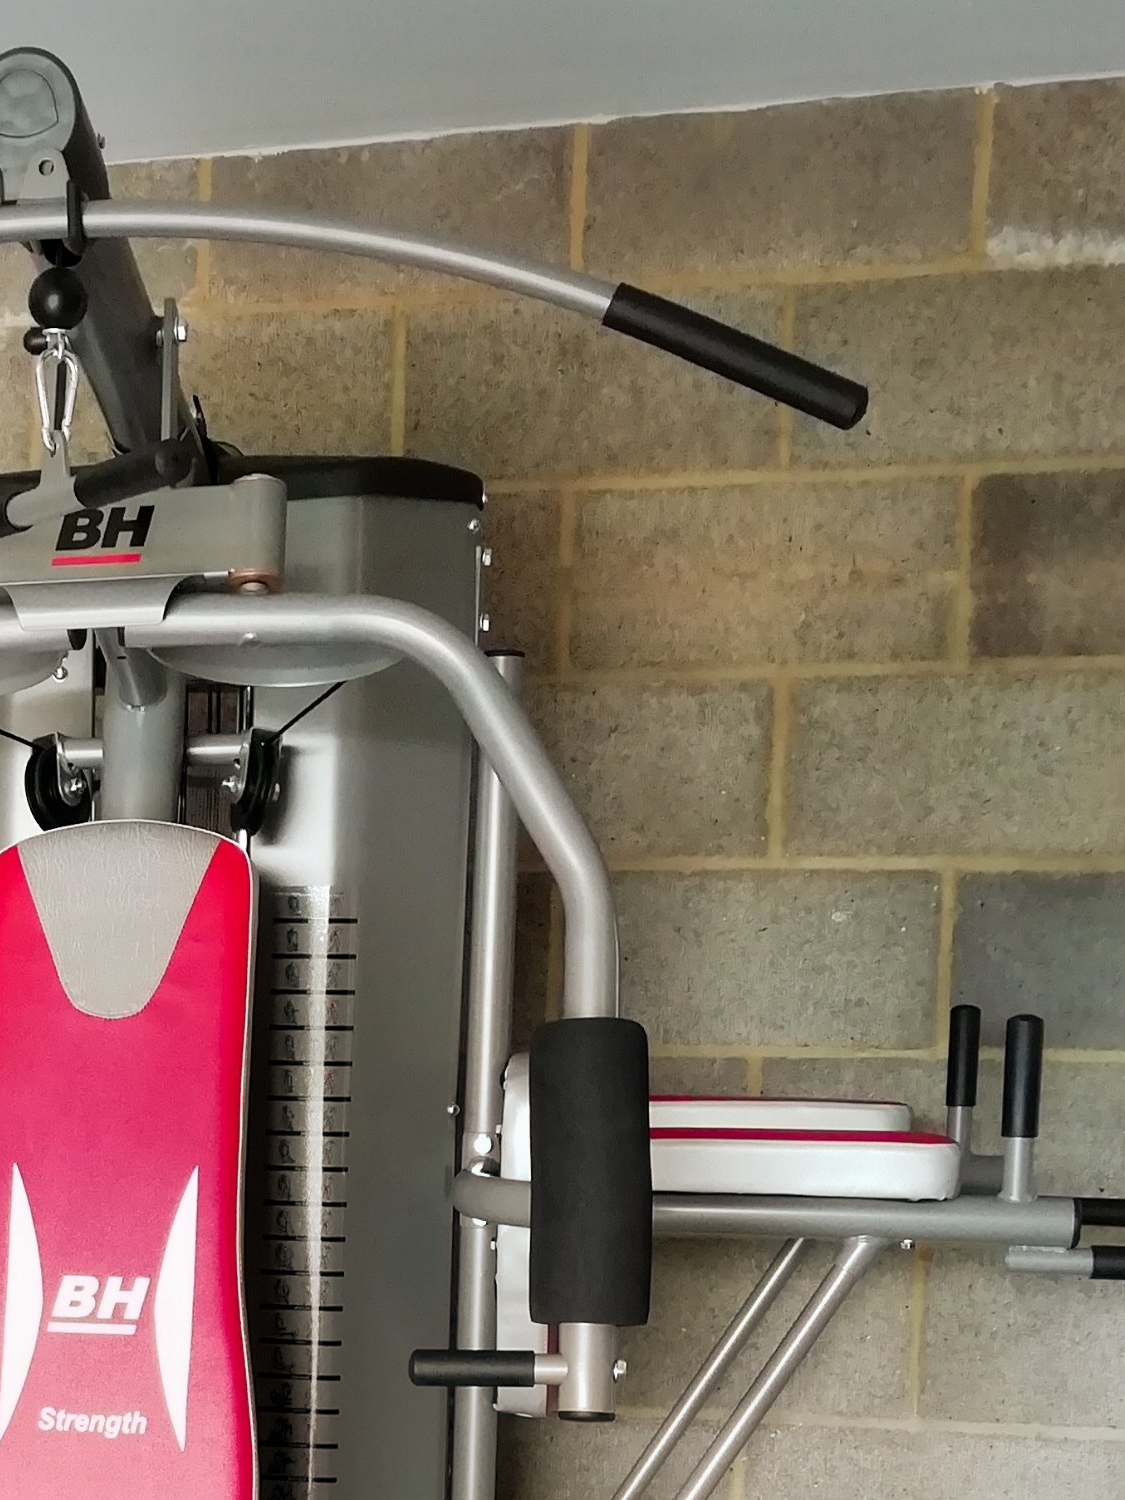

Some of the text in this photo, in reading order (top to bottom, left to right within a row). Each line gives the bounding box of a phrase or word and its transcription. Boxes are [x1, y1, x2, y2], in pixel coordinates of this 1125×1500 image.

[56, 505, 155, 551] BH
[52, 1274, 151, 1320] BH
[37, 1407, 148, 1439] Strength
